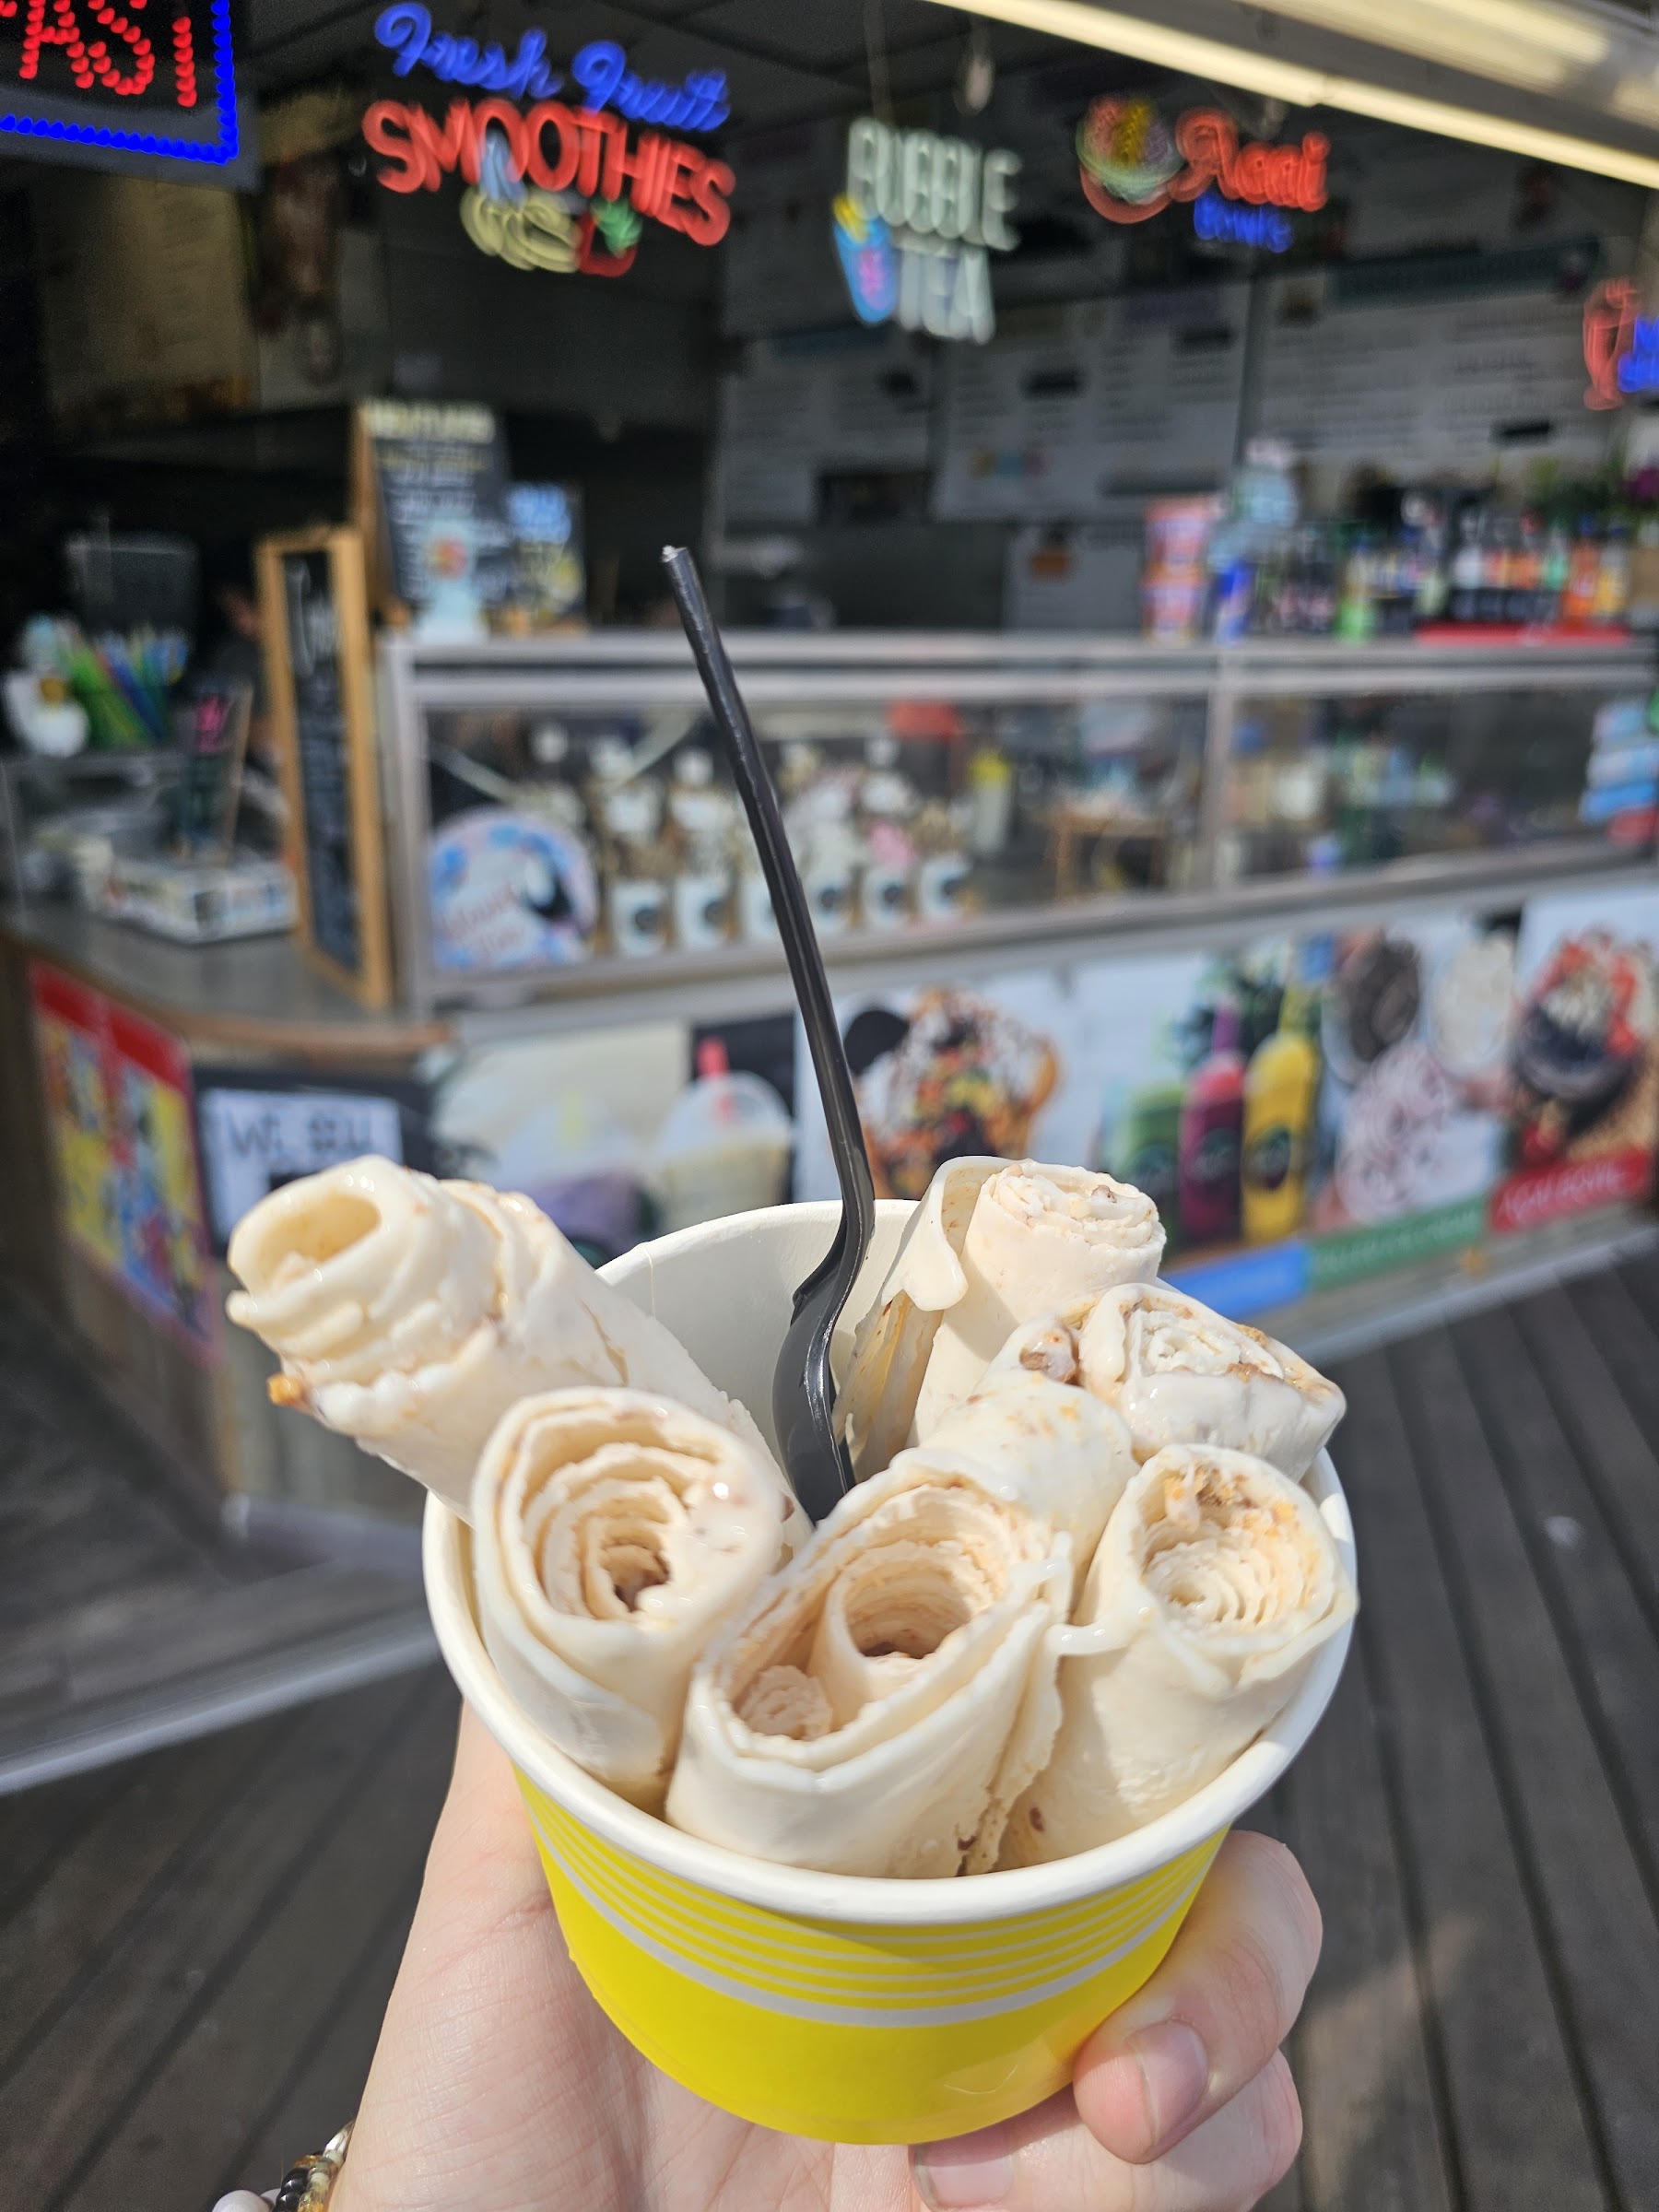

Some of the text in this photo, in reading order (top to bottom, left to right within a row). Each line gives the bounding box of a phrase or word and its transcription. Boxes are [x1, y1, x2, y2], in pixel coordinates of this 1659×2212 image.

[374, 2, 731, 131] Fresh Fruit
[361, 97, 736, 246] SMOOTHIES
[846, 116, 1023, 253] BUBBLE
